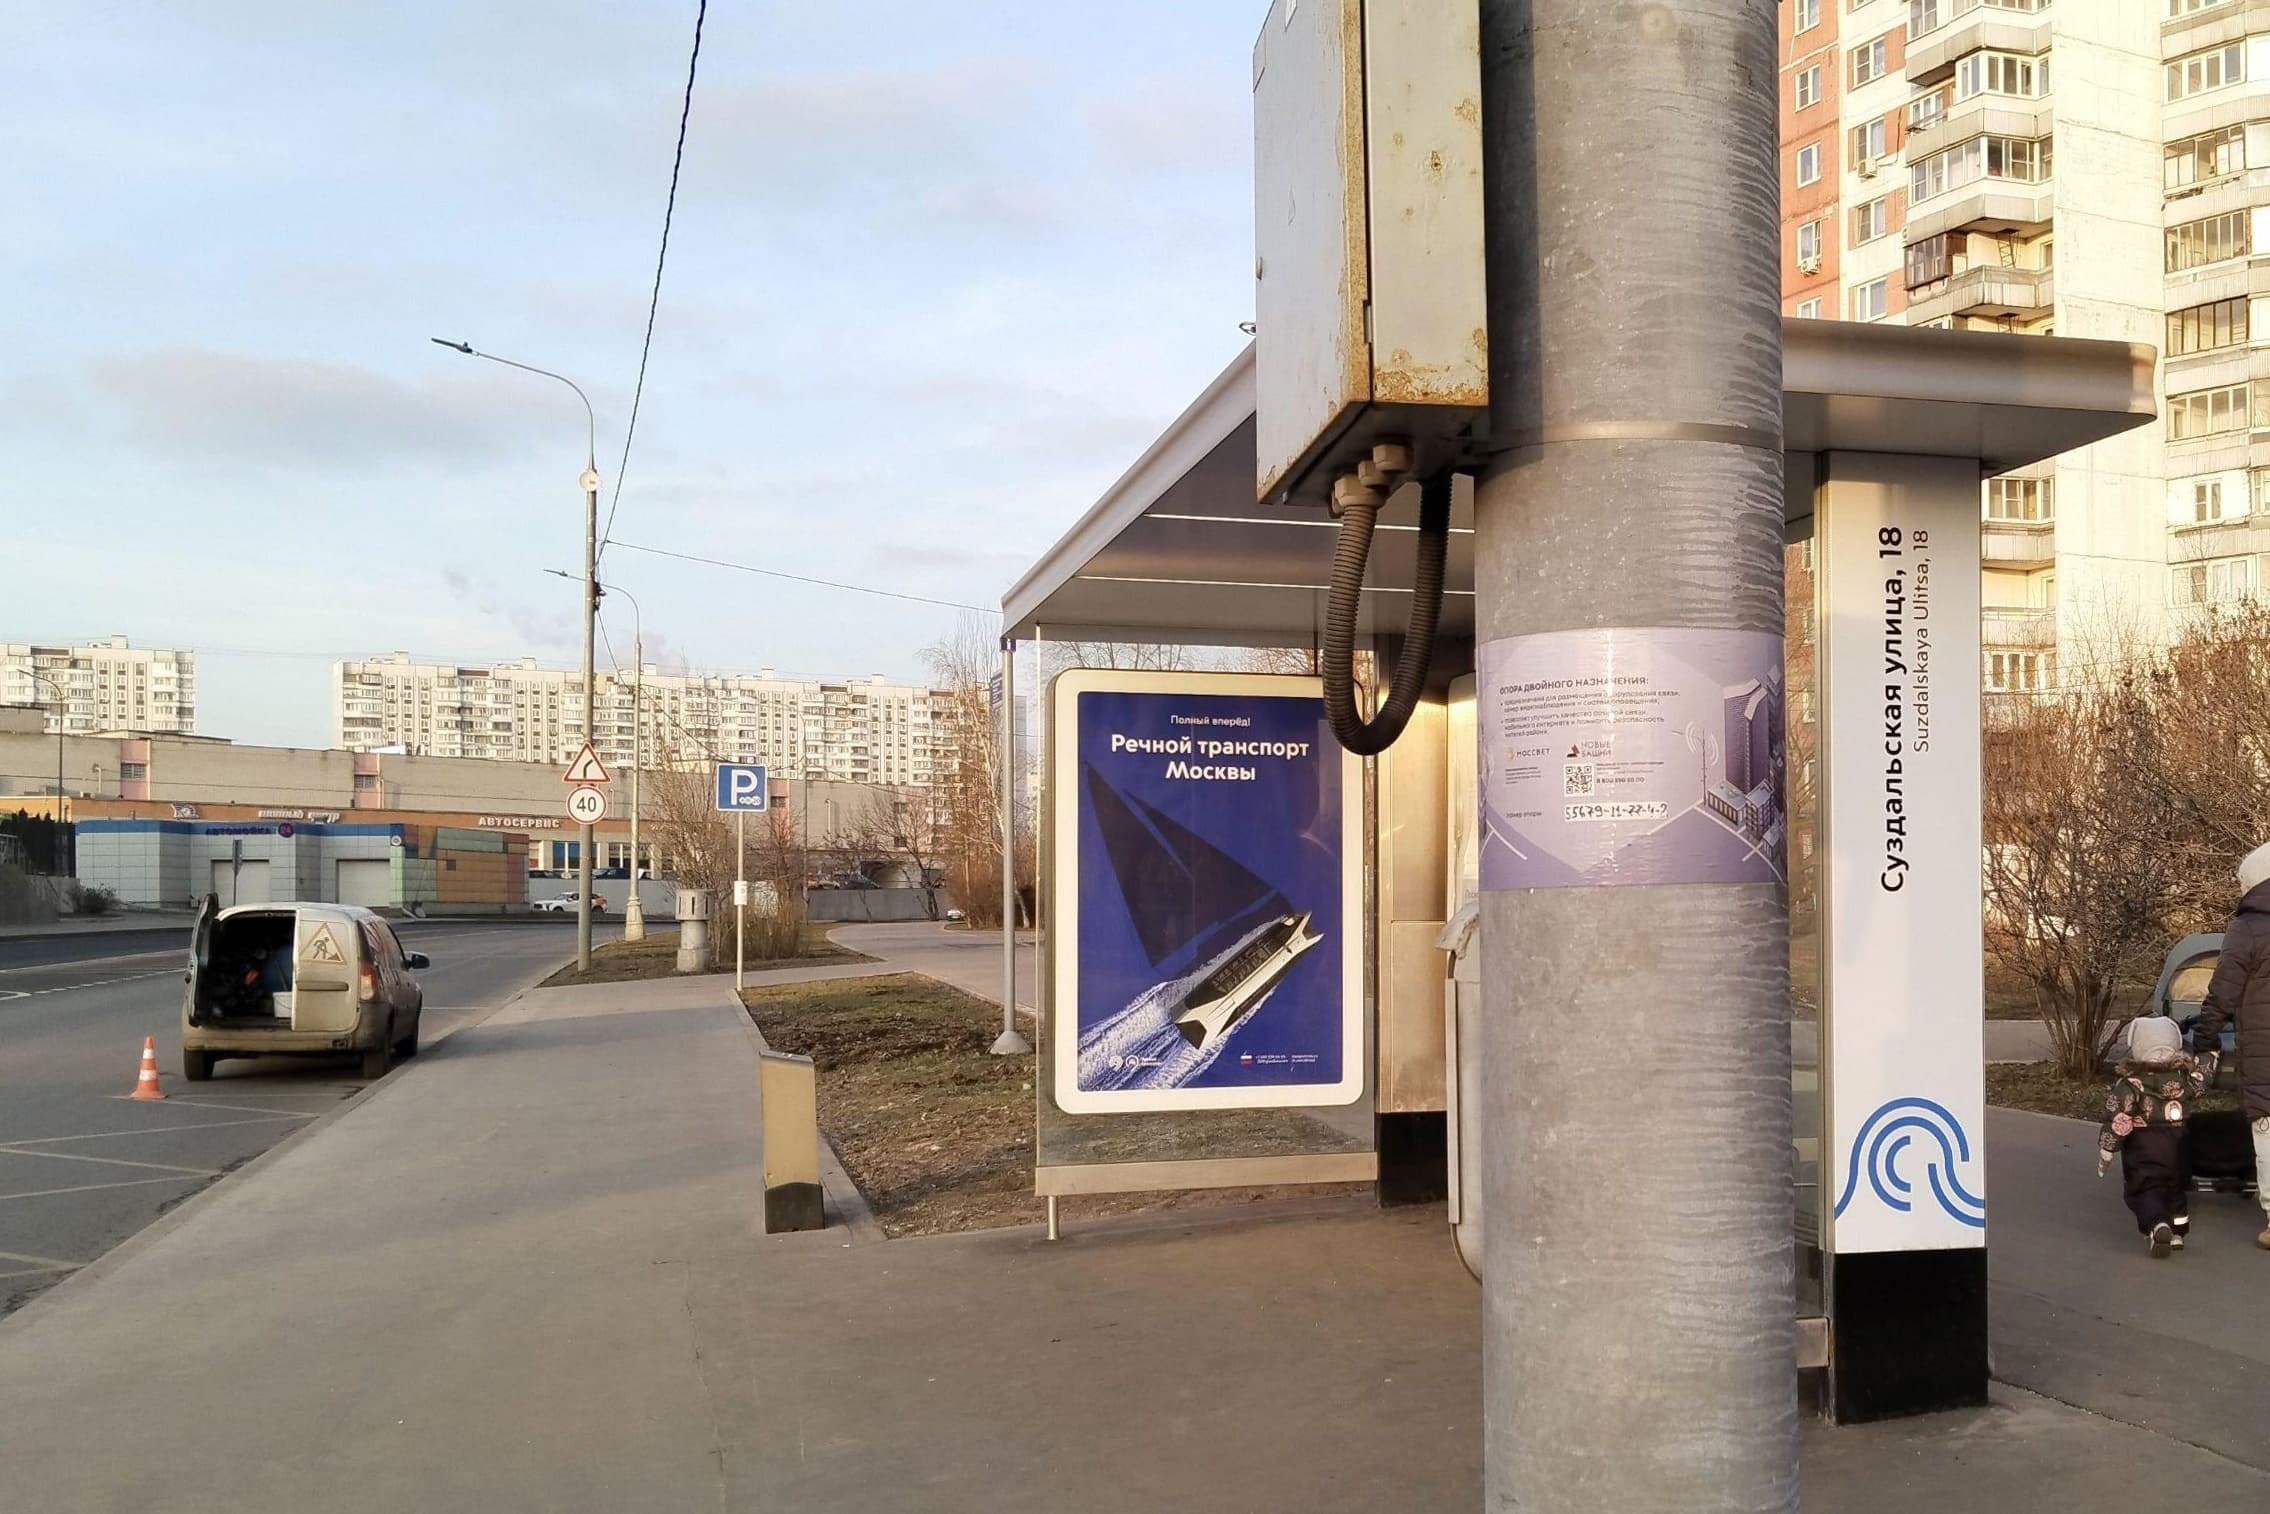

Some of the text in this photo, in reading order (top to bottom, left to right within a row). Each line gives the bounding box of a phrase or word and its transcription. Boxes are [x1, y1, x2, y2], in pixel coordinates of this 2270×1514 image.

[1912, 529, 1932, 753] Suzdalskaya Ulitsa, 18
[1499, 685, 1522, 695] ОПОРА
[1523, 680, 1574, 693] ДВОЙНОГО
[1878, 525, 1910, 893] Суздальская улица, 18
[1170, 714, 1251, 728] Полный вперёд!
[1110, 733, 1310, 760] Речной транспорт
[1516, 747, 1551, 758] МОССВЕТ
[1165, 760, 1256, 781] Москвы
[575, 796, 597, 813] 40
[478, 815, 561, 828] АВТОСЕРВИС
